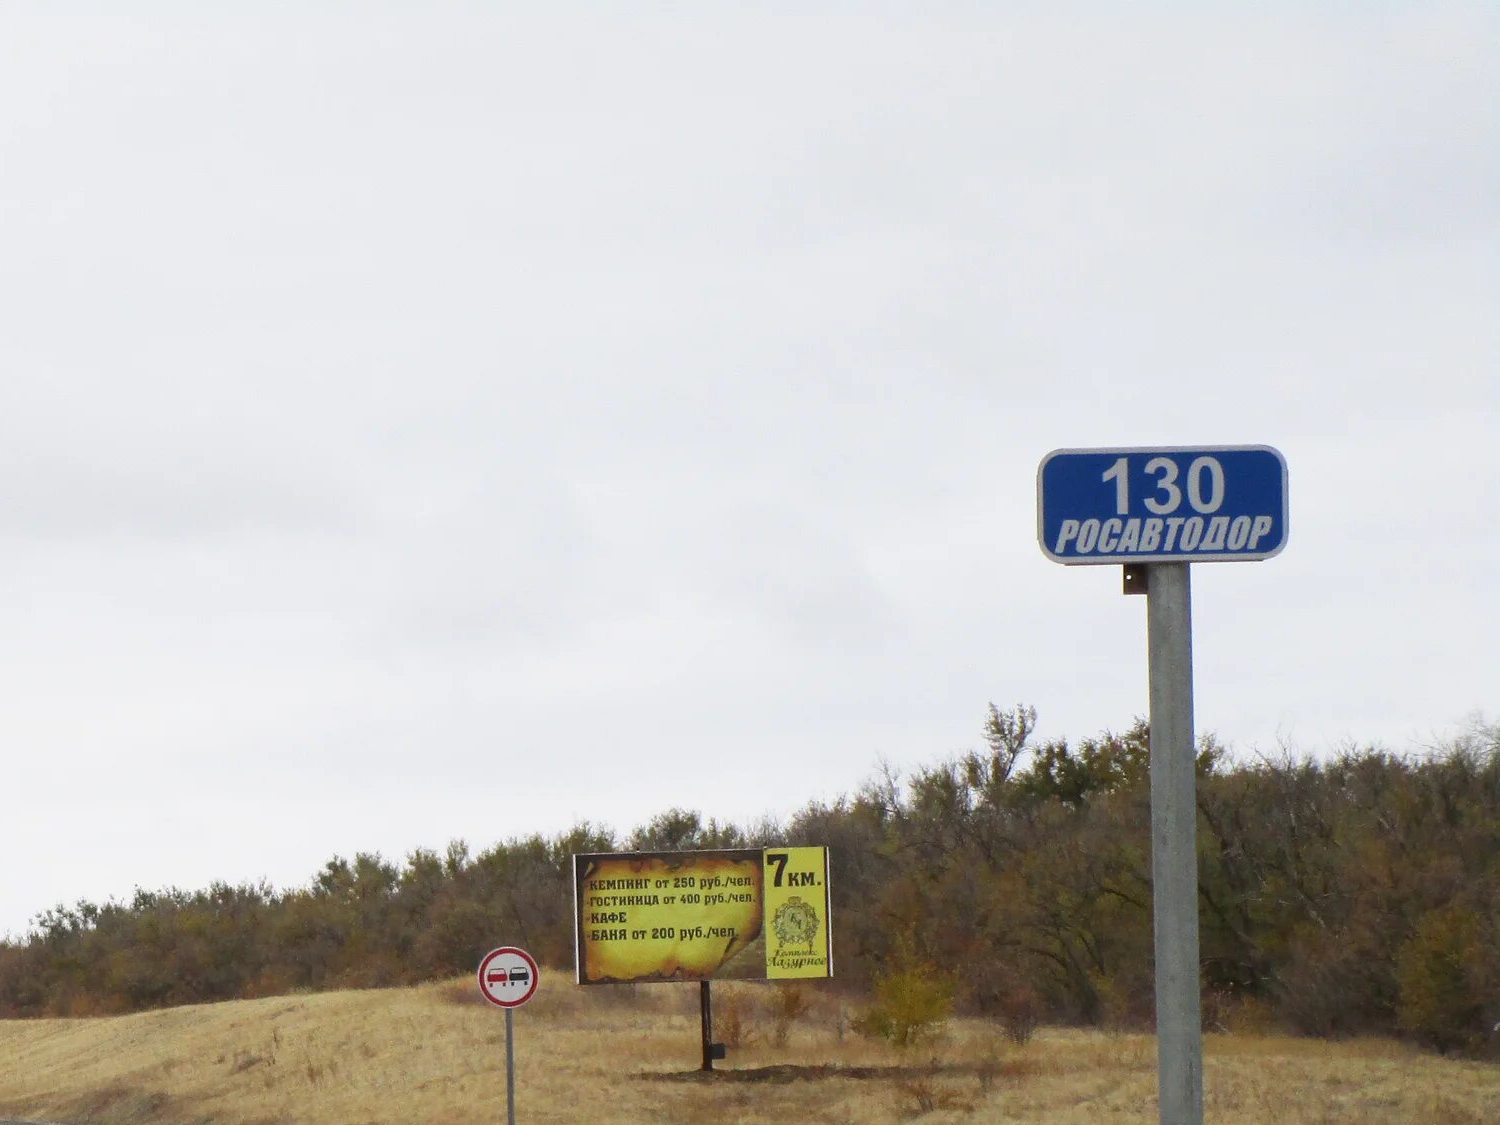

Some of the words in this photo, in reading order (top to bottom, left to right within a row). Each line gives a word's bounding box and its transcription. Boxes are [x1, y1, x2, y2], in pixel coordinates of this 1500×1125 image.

[1101, 456, 1225, 515] 130
[1054, 515, 1273, 554] РОСАВТОДОР
[589, 878, 651, 891] КЕМПИНГ
[655, 879, 670, 889] от
[673, 876, 695, 888] 250
[589, 894, 659, 907] ГОСТИНИЦА
[663, 895, 677, 905] от
[680, 893, 700, 904] 400
[591, 911, 627, 924] КАФЕ
[591, 928, 627, 941] БАНЯ
[632, 929, 647, 940] от
[652, 927, 675, 939] 200
